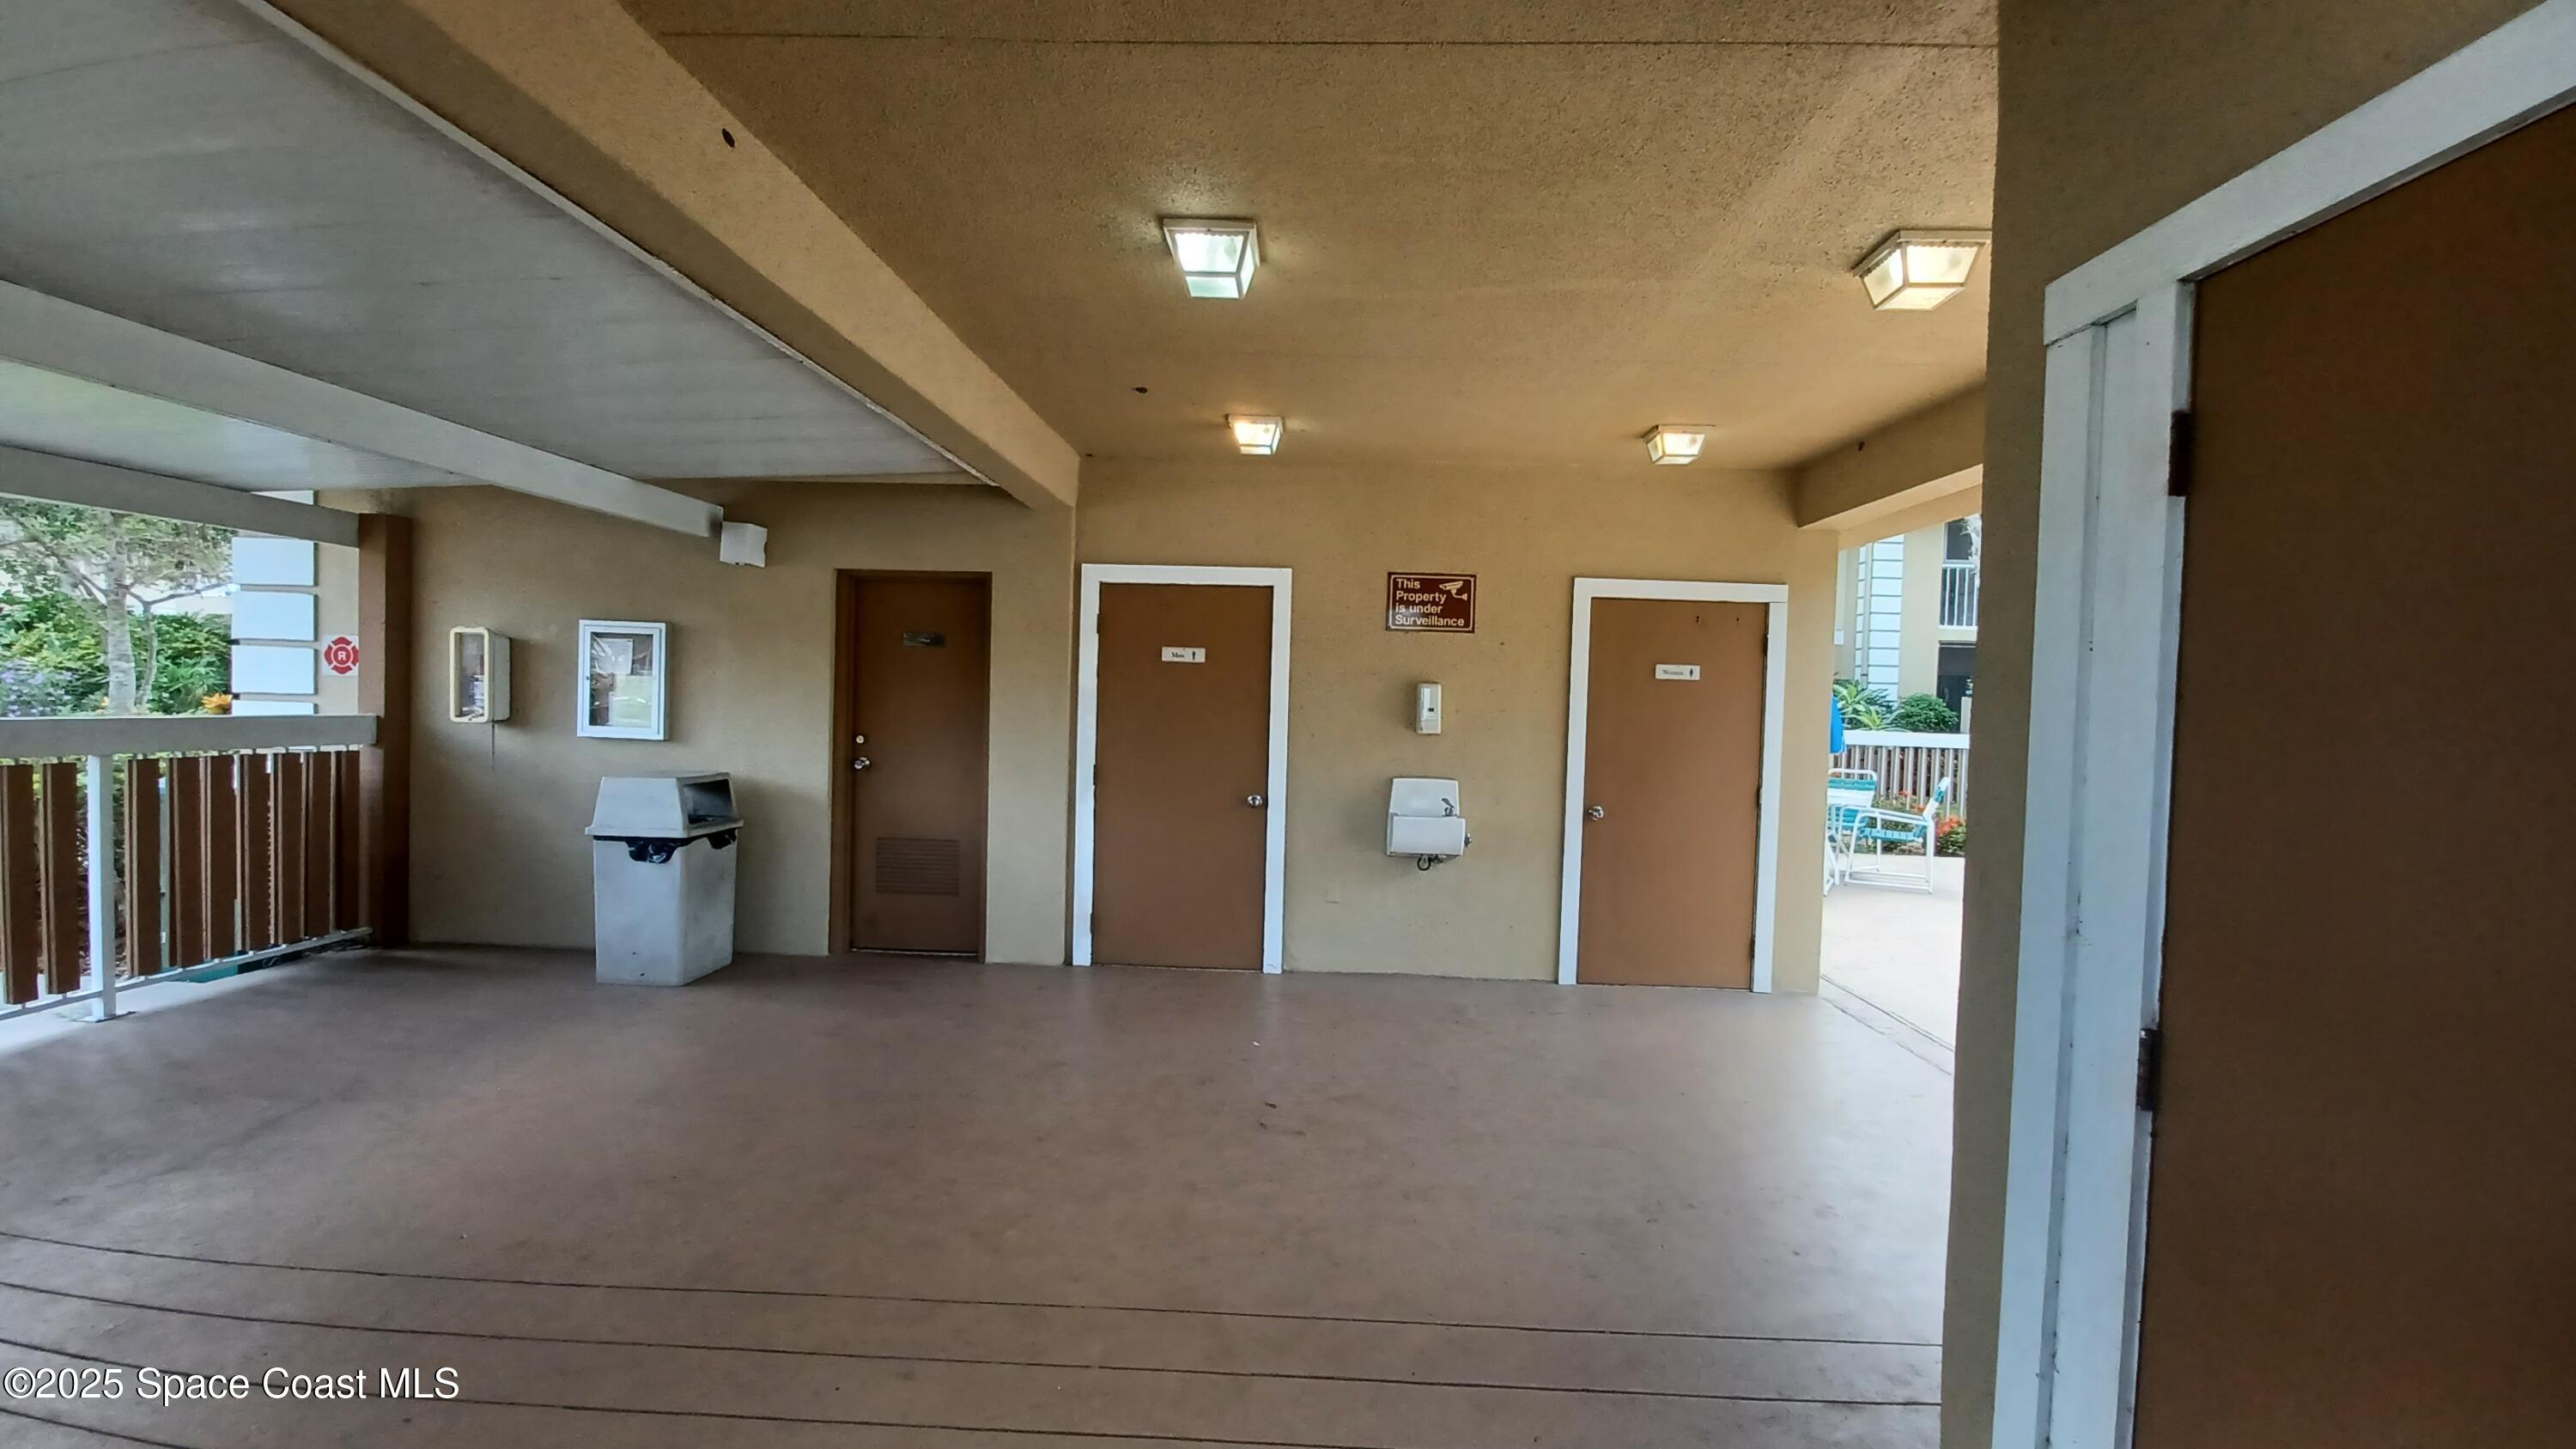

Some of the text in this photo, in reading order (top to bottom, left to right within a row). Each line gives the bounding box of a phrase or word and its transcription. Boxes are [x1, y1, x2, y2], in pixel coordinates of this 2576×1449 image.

[1396, 579, 1420, 589] This
[1396, 591, 1447, 604] Property
[1395, 603, 1443, 613] is under
[1395, 614, 1465, 626] Surveillance
